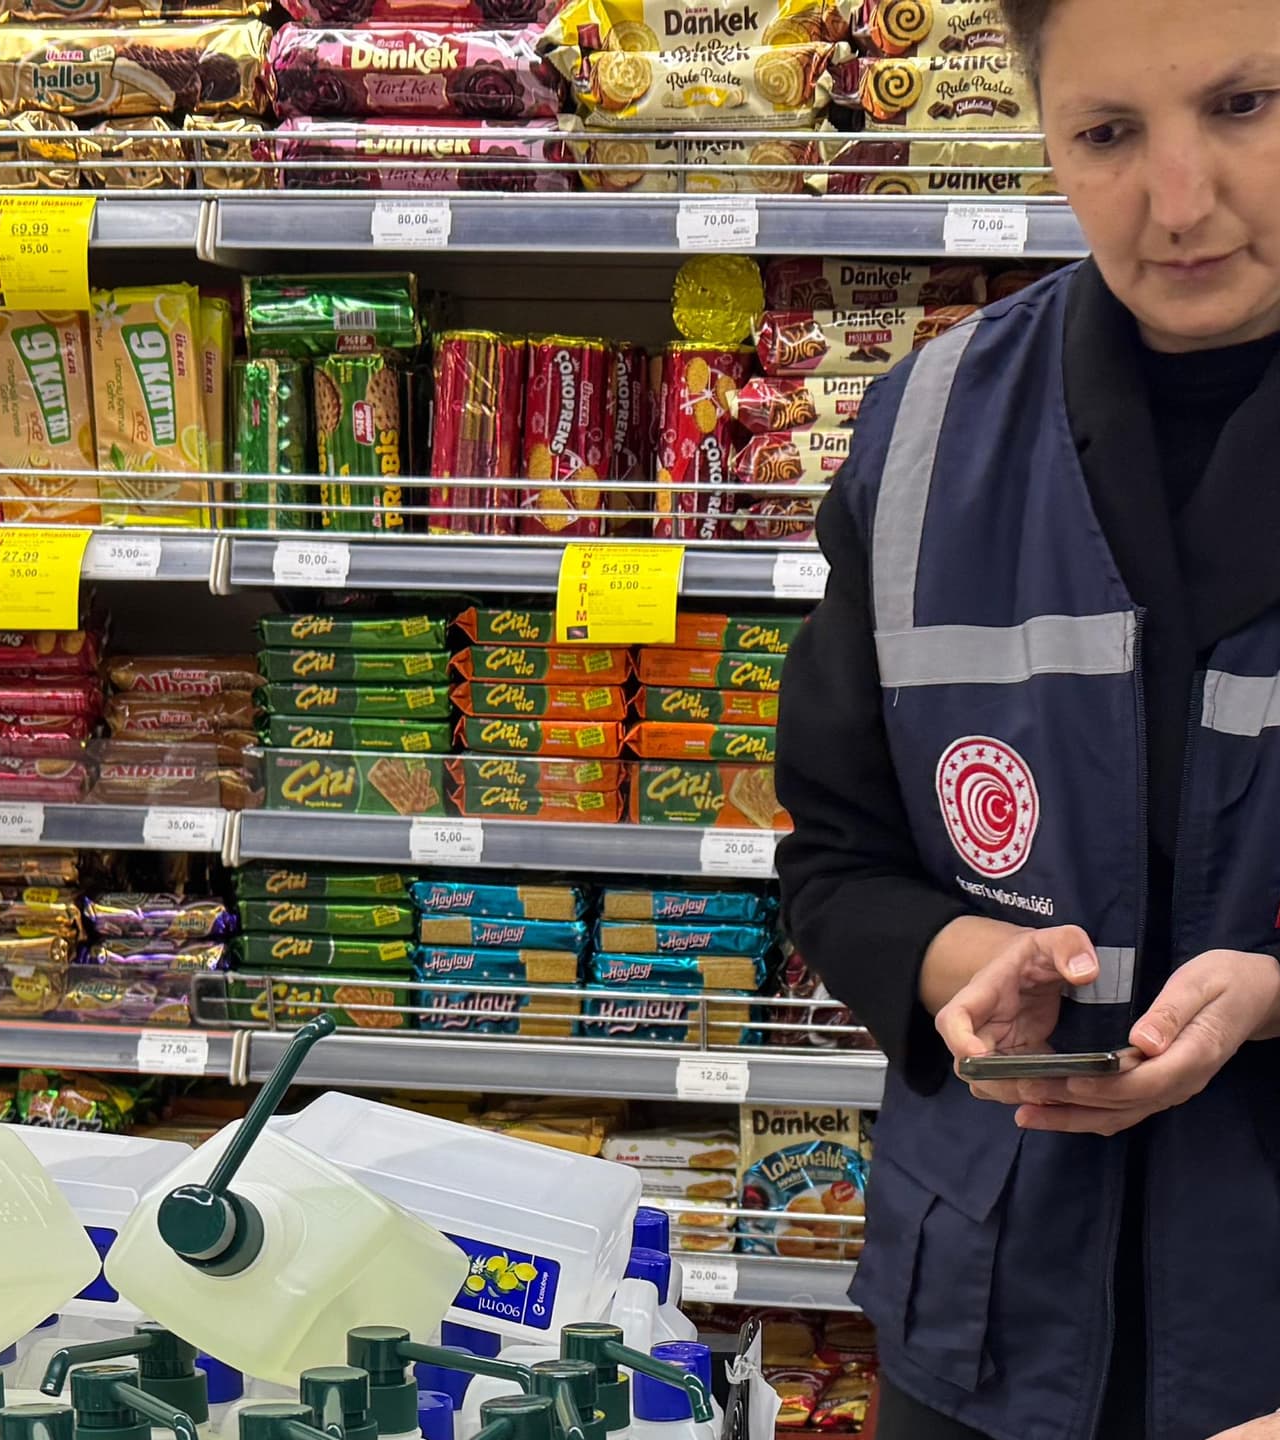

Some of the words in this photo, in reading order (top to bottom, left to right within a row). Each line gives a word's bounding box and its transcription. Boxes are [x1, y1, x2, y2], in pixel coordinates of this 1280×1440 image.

[664, 7, 759, 38] Dankek
[349, 43, 459, 75] Dankek
[32, 65, 102, 102] halley
[666, 71, 701, 89] Rulo
[703, 67, 744, 87] Pasta
[935, 79, 971, 98] Rulo
[972, 75, 1015, 96] Pasta
[398, 214, 429, 226] 80,00
[703, 214, 735, 227] 70,00
[971, 219, 1004, 231] 70,00
[10, 223, 49, 236] 69,99
[20, 243, 49, 255] 95,00
[839, 266, 913, 289] Dankek
[830, 307, 907, 329] Dankek
[21, 333, 55, 362] 9
[128, 330, 167, 360] 9
[174, 330, 186, 377] ÜLKER
[548, 350, 577, 455] ÇOKOPRENS
[2, 550, 40, 563] 27,99
[110, 548, 140, 559] 35,00
[298, 553, 328, 566] 80,00
[9, 568, 38, 579] 35,00
[601, 563, 640, 575] 54,99
[609, 580, 640, 591] 63,00
[291, 615, 333, 639] Çizi
[490, 610, 530, 635] Çizi
[281, 760, 357, 804] Çizi
[647, 766, 711, 804] Çizi
[166, 819, 196, 831] 35,00
[434, 831, 462, 843] 15,00
[724, 843, 754, 854] 20,00
[160, 1043, 188, 1055] 27,50
[700, 1069, 728, 1082] 12,50
[751, 1108, 852, 1137] Dankek
[763, 1148, 848, 1183] Lokmalık
[690, 1270, 718, 1281] 20,00
